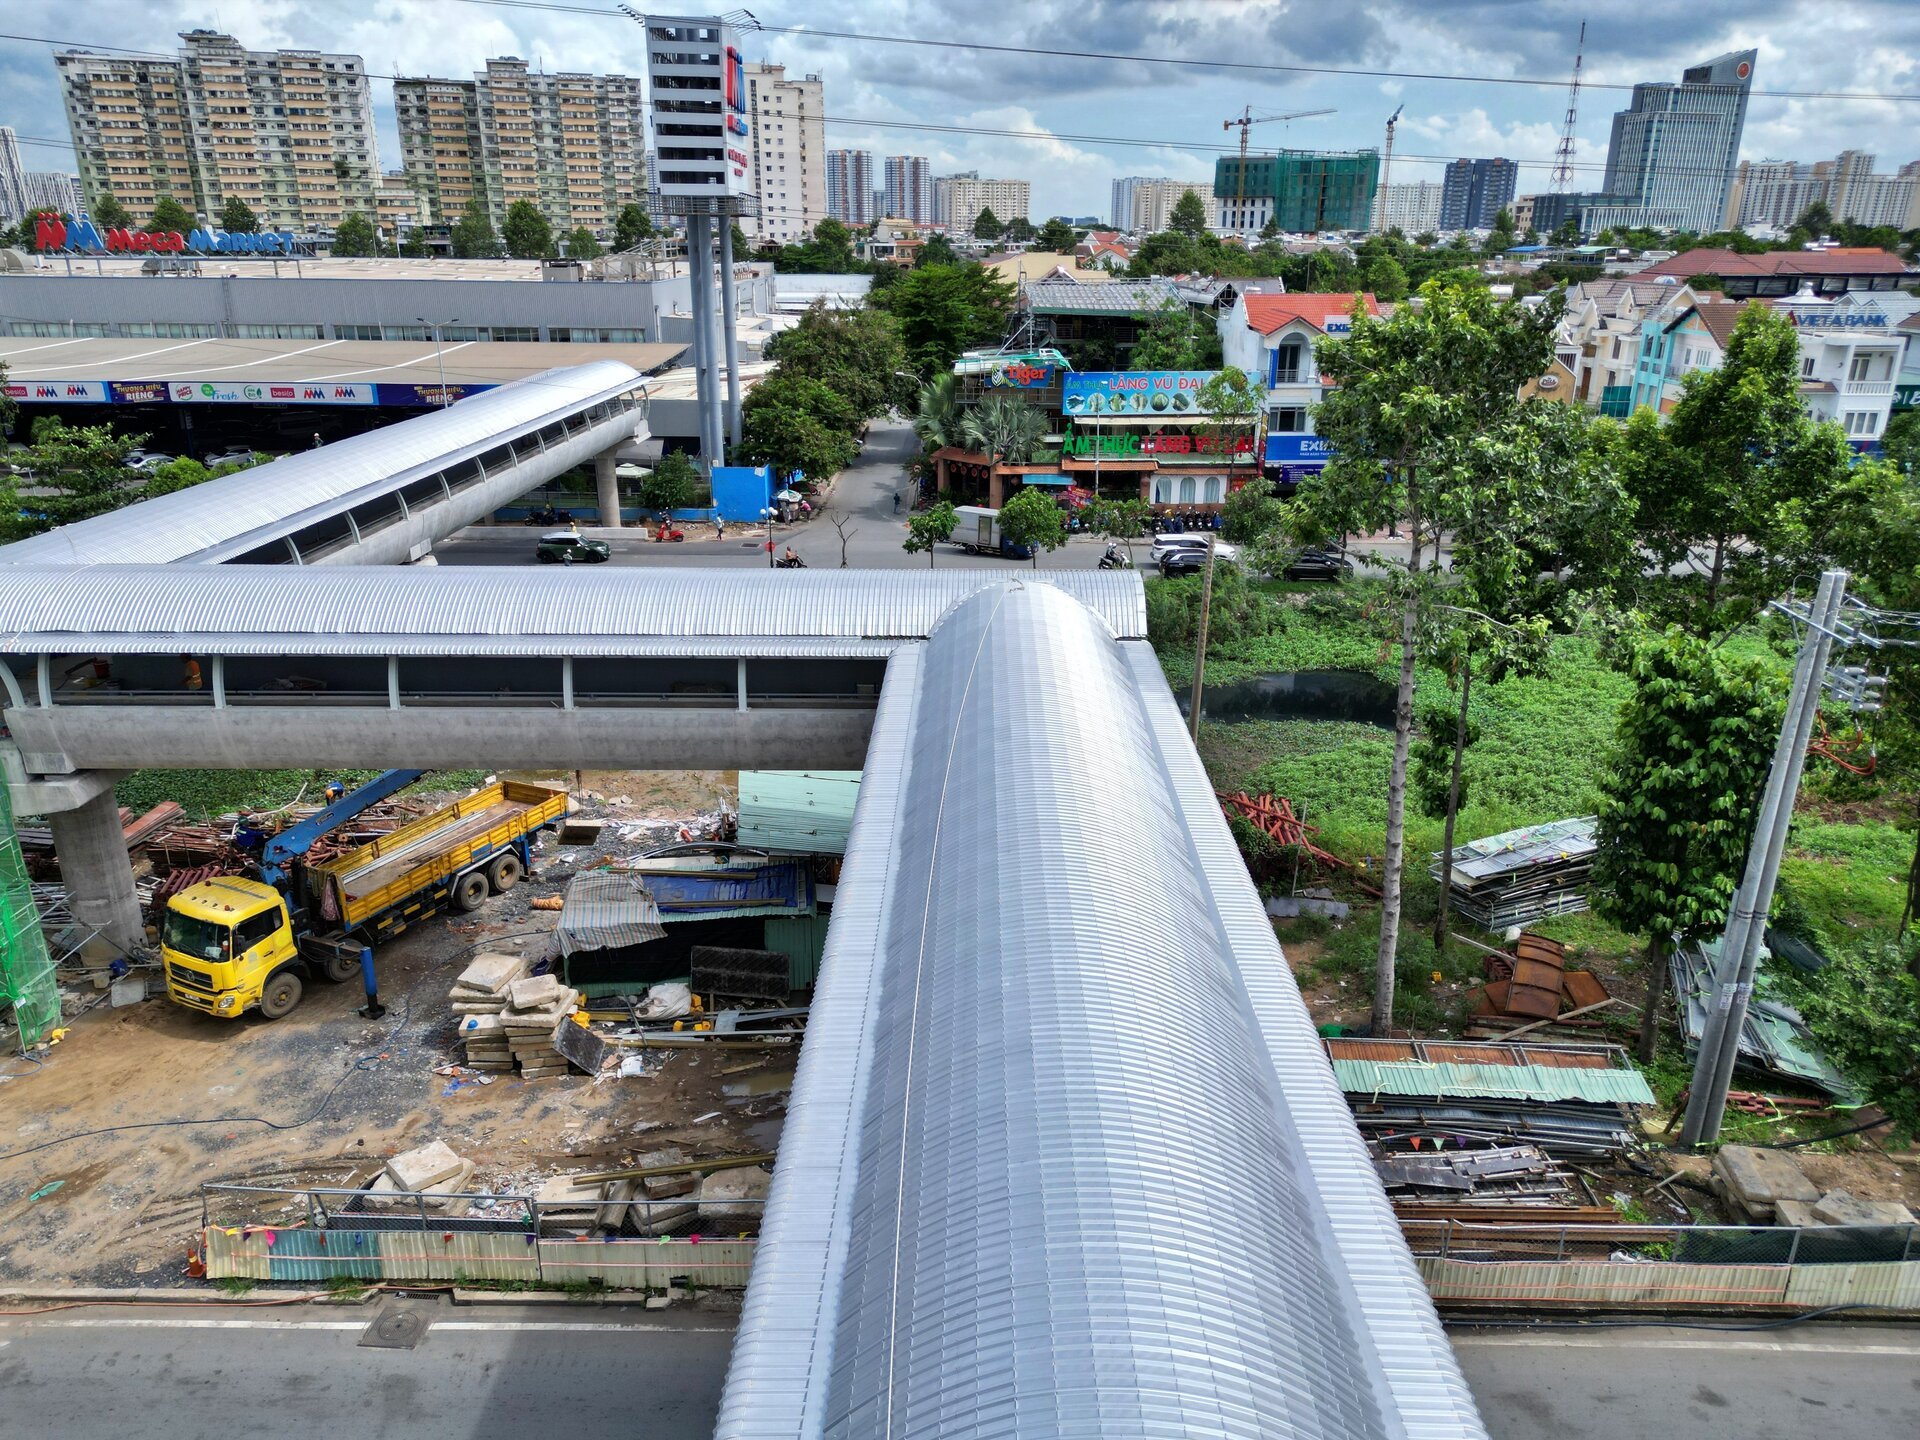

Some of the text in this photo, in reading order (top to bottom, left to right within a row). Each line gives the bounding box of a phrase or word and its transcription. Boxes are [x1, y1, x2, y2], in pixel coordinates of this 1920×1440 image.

[1007, 364, 1047, 385] Tiger
[1154, 376, 1173, 389] VŨ
[1143, 430, 1190, 455] LÀNG
